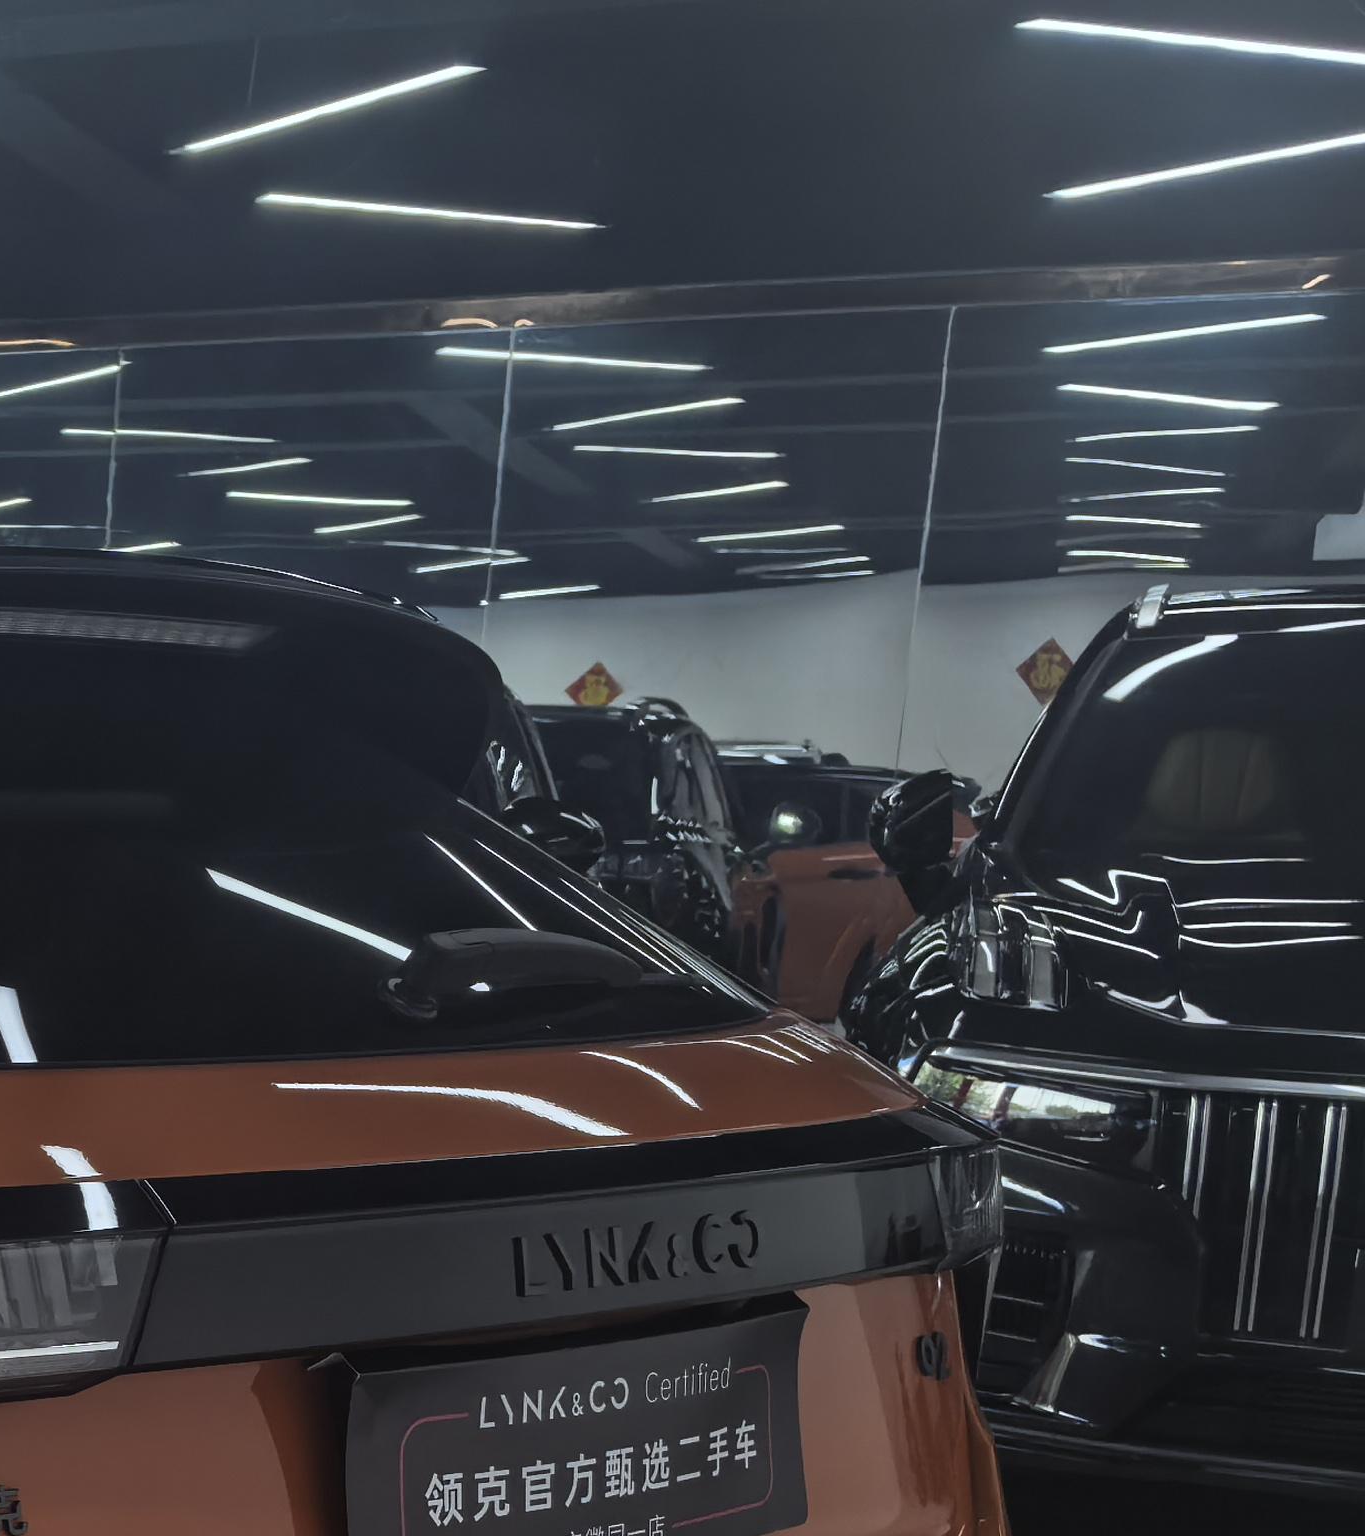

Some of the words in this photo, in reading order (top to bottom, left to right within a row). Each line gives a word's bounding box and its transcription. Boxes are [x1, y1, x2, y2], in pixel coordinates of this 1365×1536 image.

[512, 1210, 758, 1297] LYNK&CO
[480, 1377, 630, 1428] LYNK&CO
[645, 1357, 732, 1403] Certified
[424, 1419, 758, 1527] 领克官方甄选二手车
